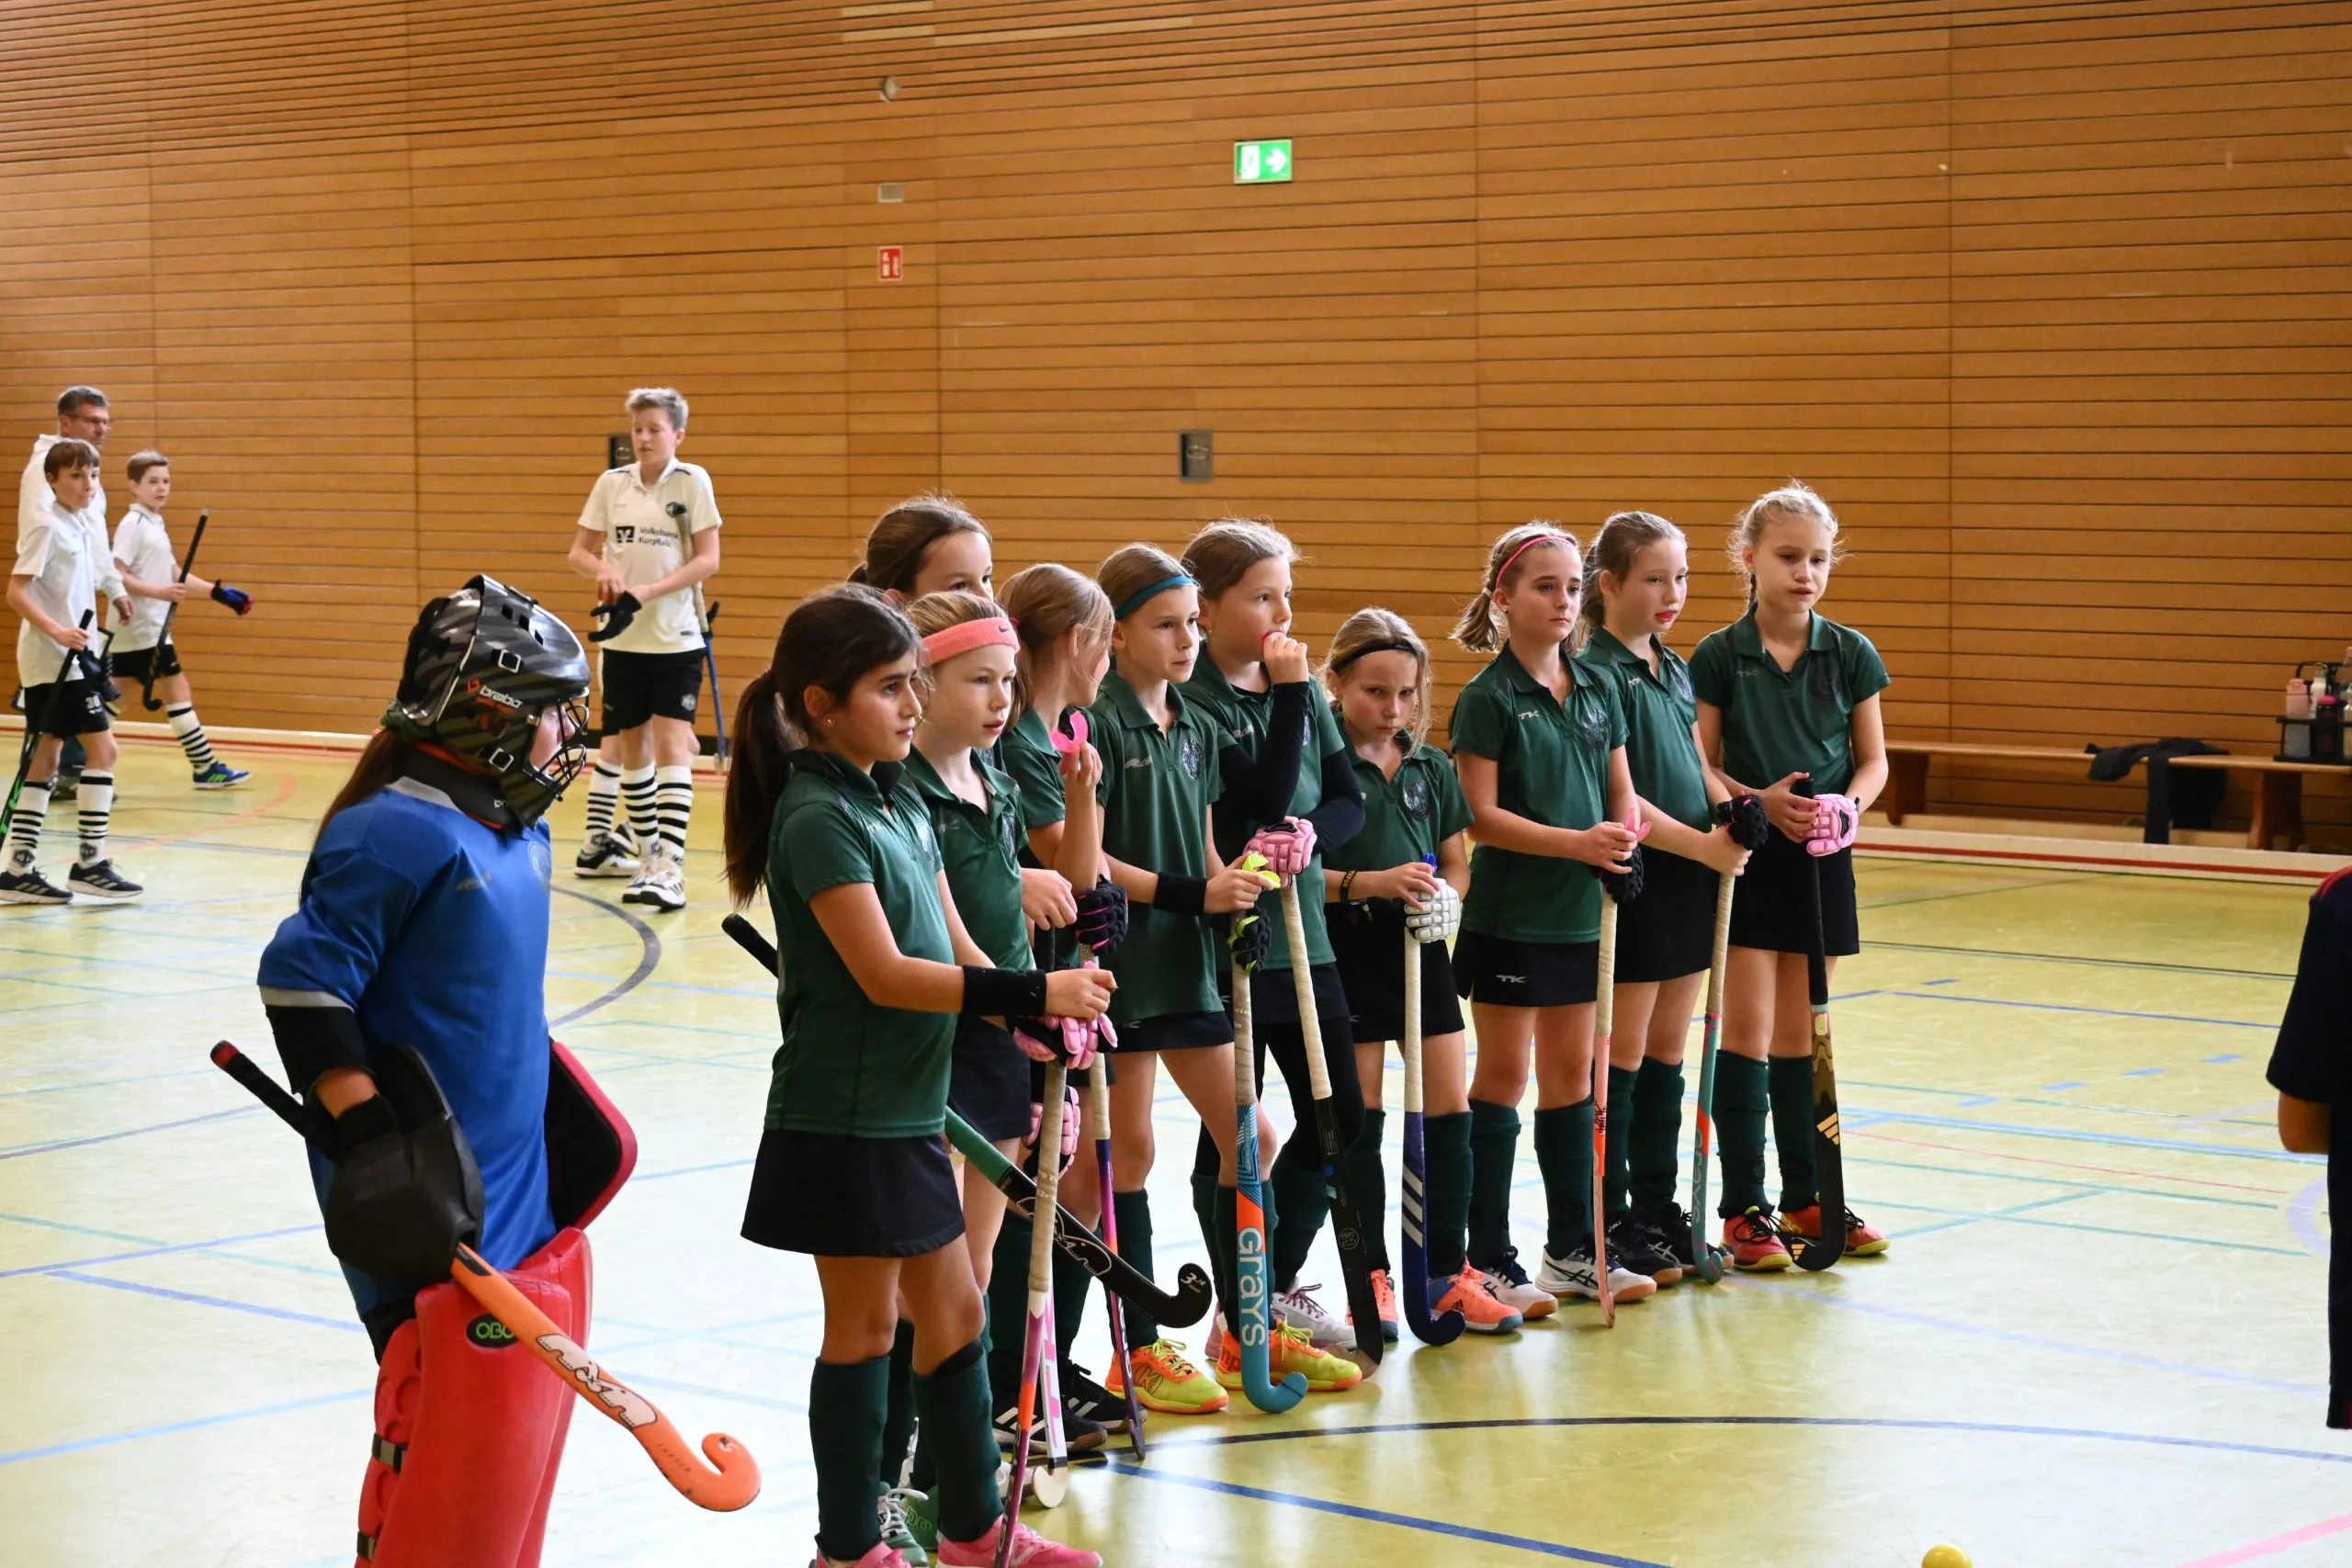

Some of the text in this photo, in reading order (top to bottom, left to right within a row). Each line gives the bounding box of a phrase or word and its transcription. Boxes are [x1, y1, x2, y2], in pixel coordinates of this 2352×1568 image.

[479, 685, 523, 709] brabo
[1518, 710, 1539, 720] TK
[1496, 974, 1528, 984] TK
